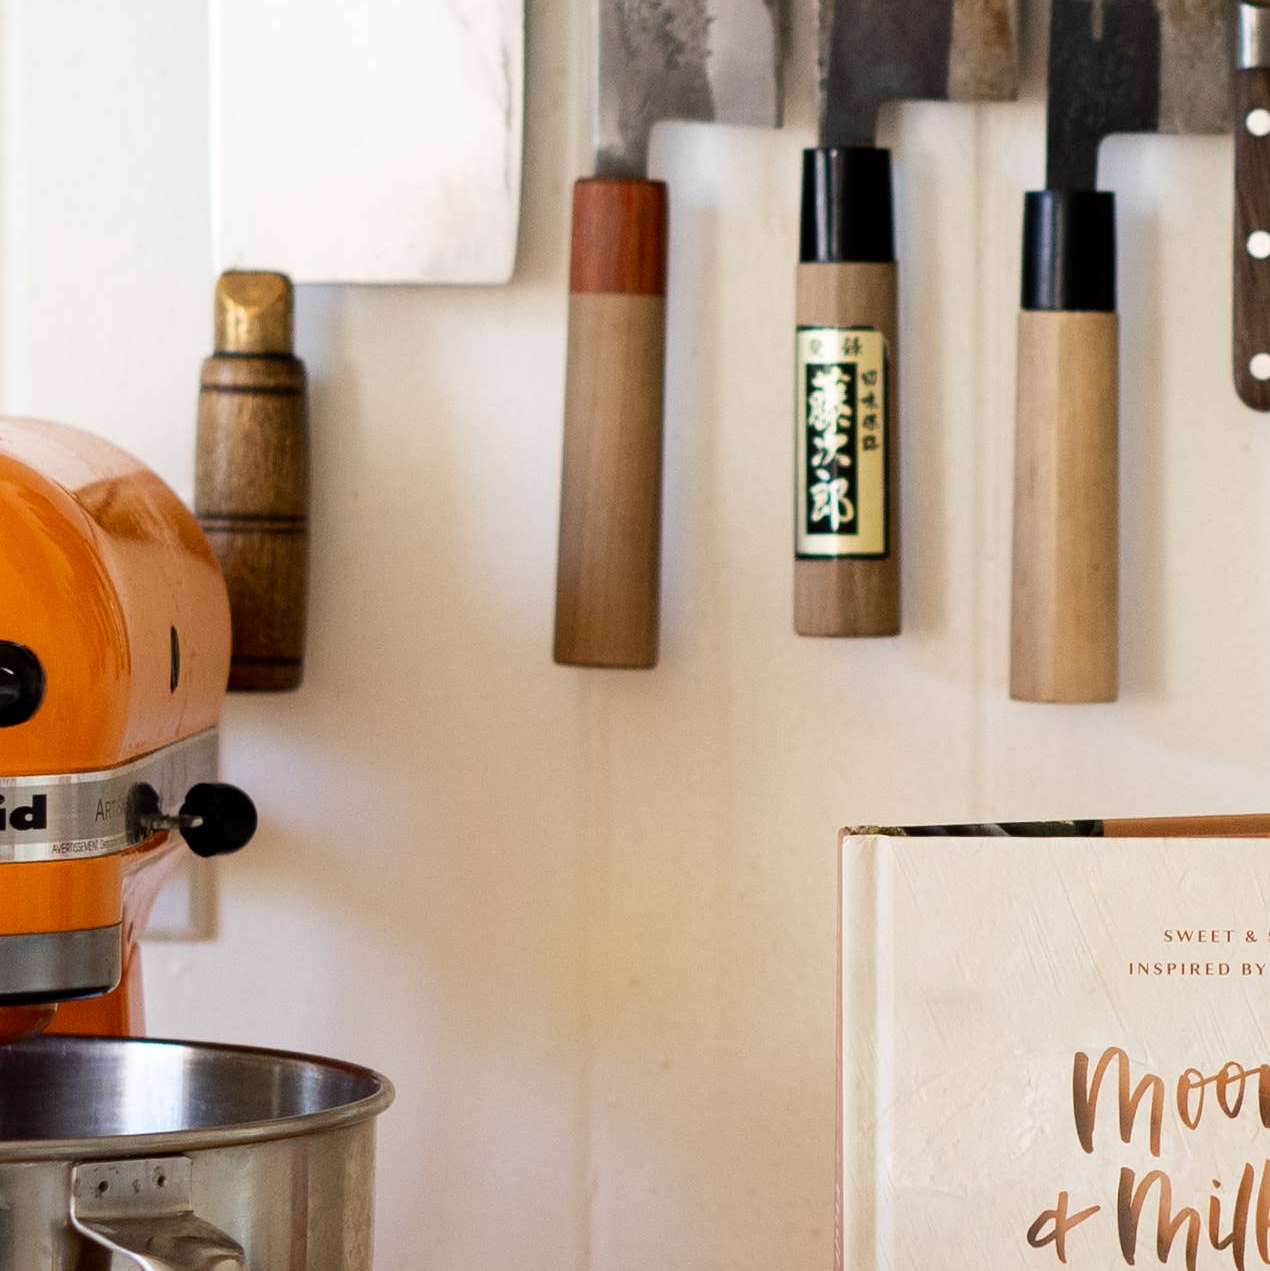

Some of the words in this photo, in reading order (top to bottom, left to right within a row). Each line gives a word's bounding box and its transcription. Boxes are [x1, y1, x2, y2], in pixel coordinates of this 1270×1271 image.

[1163, 929, 1238, 944] SWEET
[1244, 929, 1258, 944] &
[1128, 962, 1230, 976] INSPIRED
[1241, 962, 1266, 976] BY
